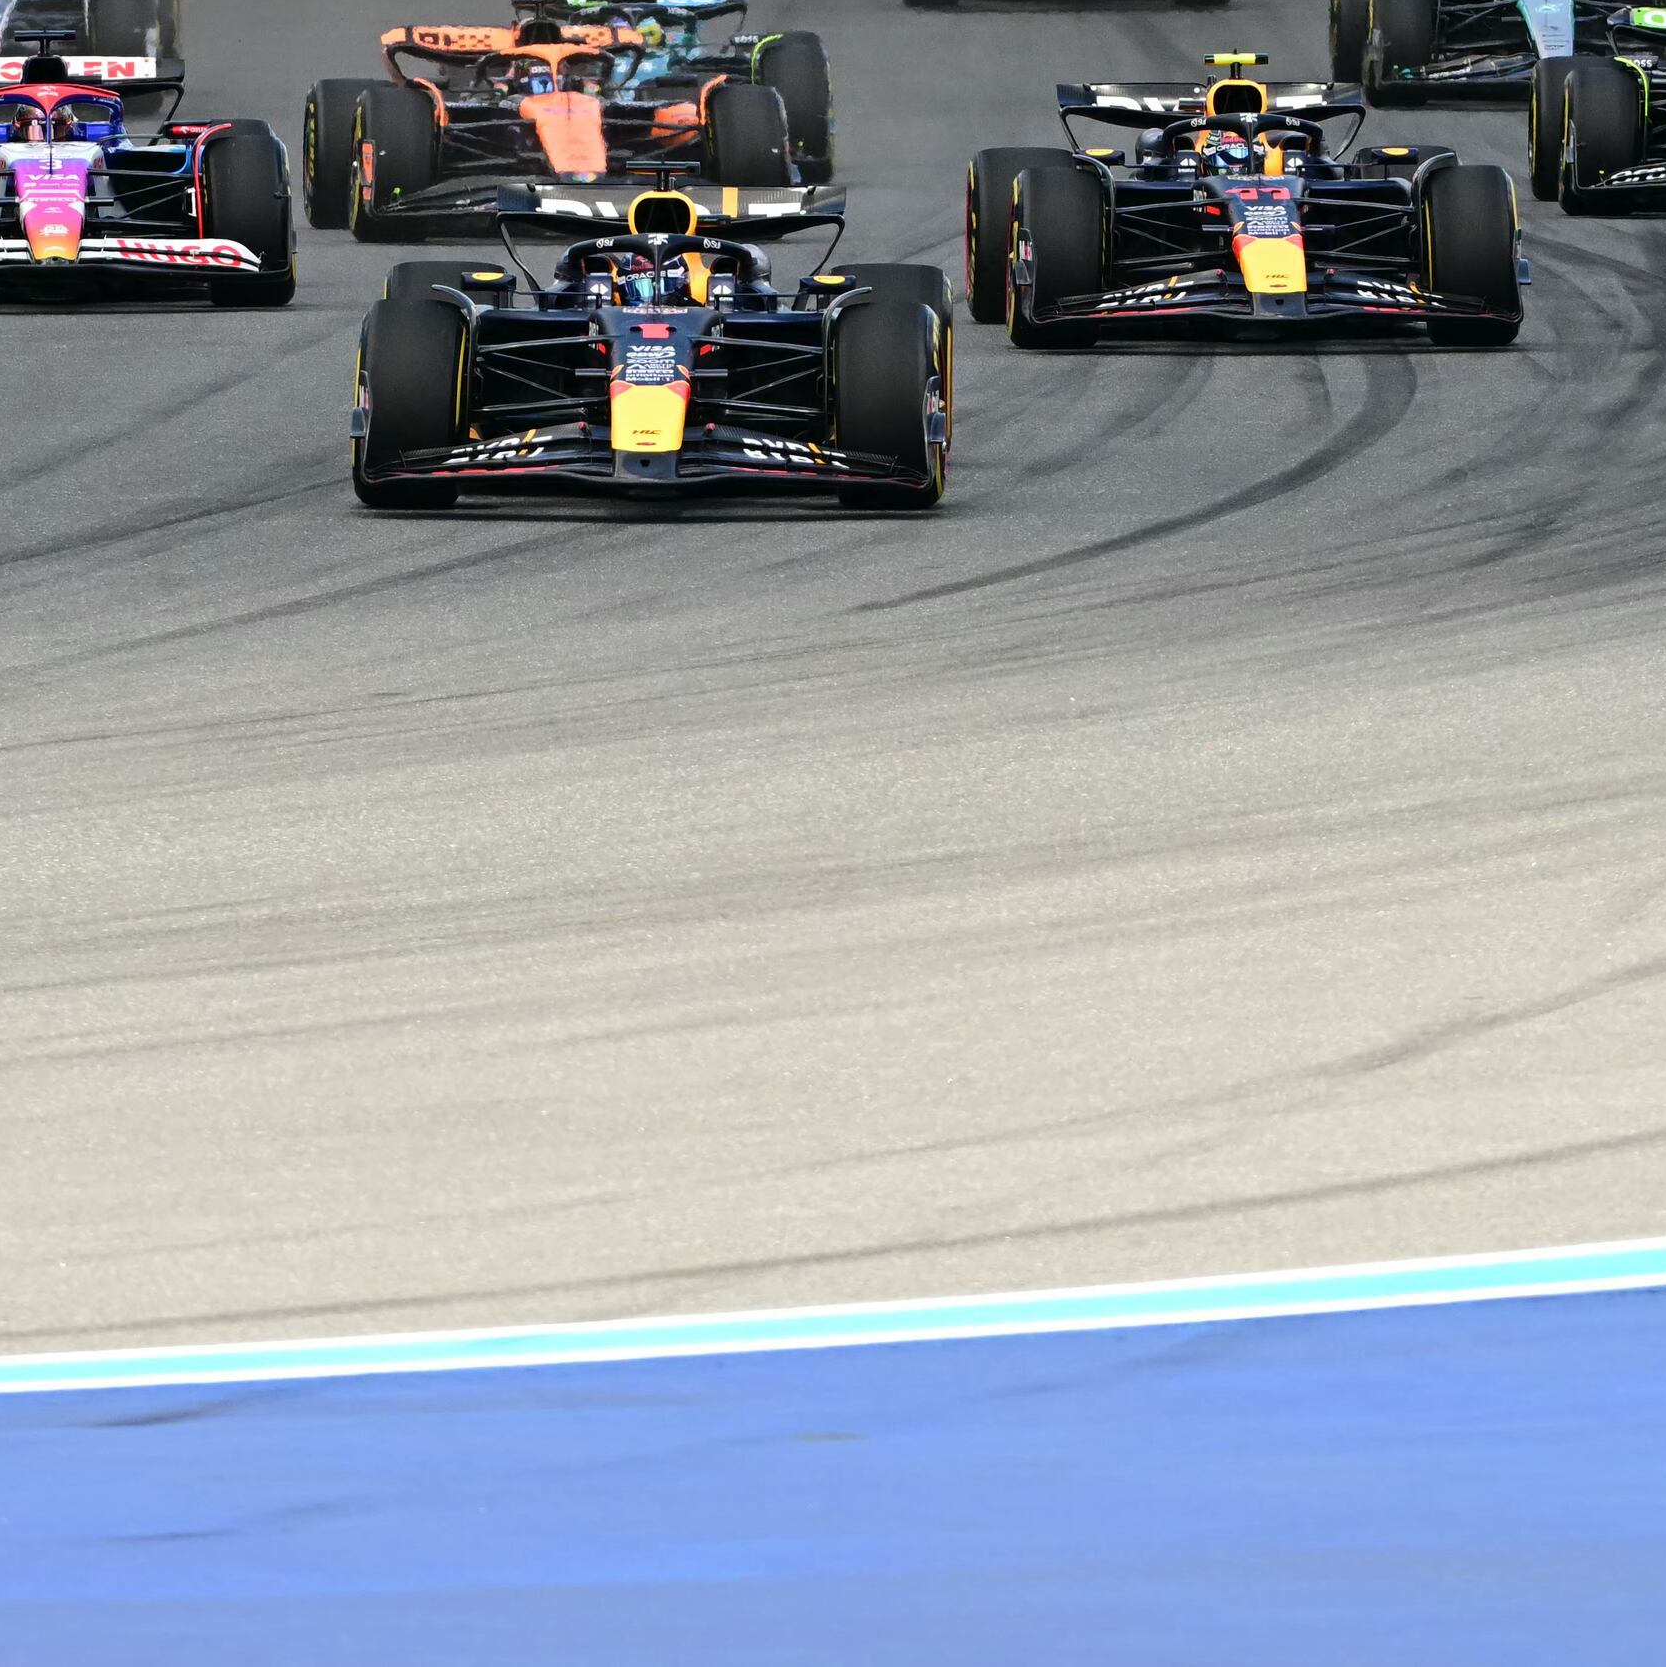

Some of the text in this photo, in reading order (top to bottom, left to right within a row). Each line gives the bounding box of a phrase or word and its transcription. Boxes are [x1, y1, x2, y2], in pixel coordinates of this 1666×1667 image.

[1217, 144, 1247, 152] ORACL
[118, 239, 242, 266] HUGO
[626, 270, 666, 281] ORACE
